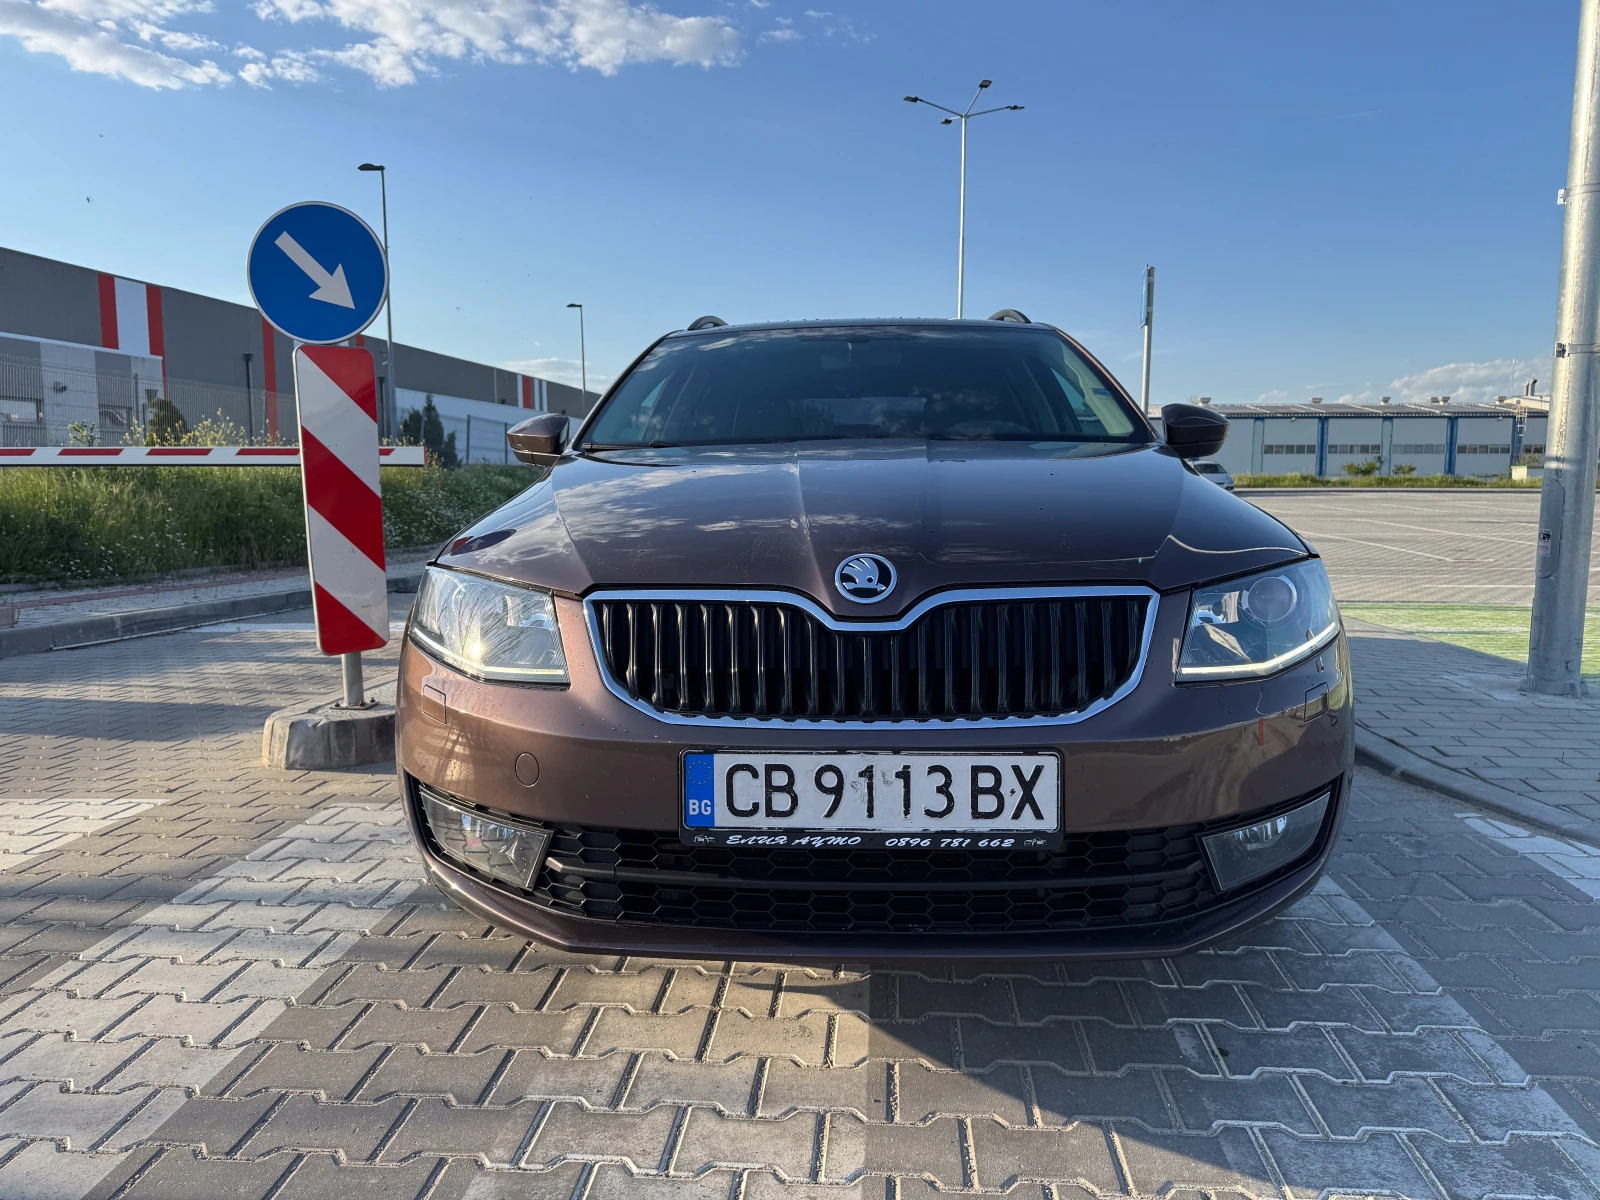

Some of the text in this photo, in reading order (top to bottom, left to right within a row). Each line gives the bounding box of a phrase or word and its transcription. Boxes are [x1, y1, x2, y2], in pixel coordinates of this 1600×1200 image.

[725, 763, 1045, 821] CB 9113 BX
[689, 799, 712, 816] BG
[885, 837, 931, 848] 0896
[940, 838, 971, 848] 781
[978, 838, 1015, 848] 662
